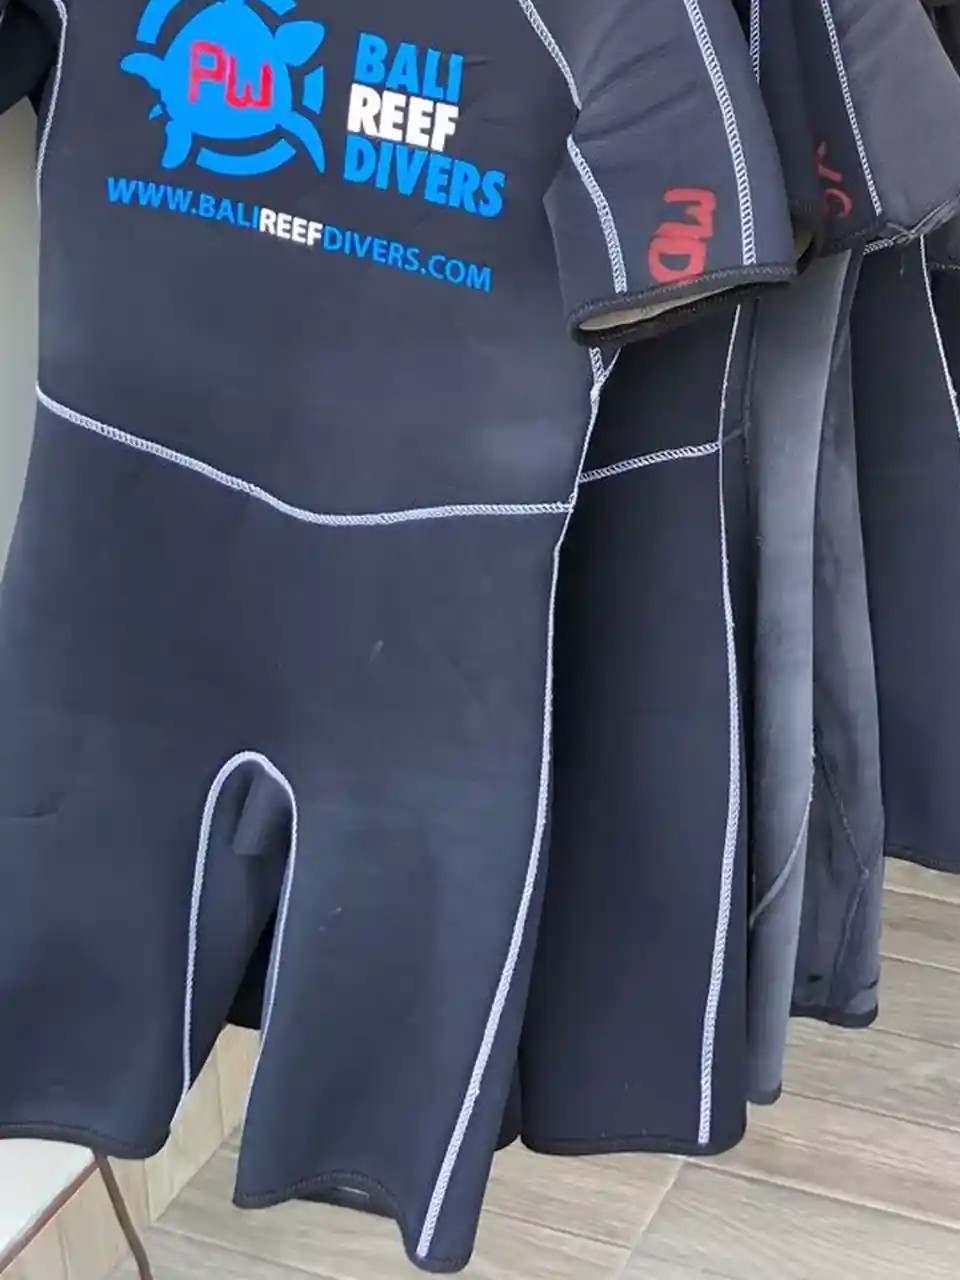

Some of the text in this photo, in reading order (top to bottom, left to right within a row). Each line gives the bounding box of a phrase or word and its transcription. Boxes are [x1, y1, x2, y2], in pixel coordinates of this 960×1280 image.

[186, 40, 275, 109] PW
[353, 31, 463, 103] BALI
[346, 82, 459, 153] REEF
[342, 135, 507, 218] DIVERS
[106, 176, 493, 293] WWW.BALIREEFDIVERS.COM
[647, 187, 717, 284] MD
